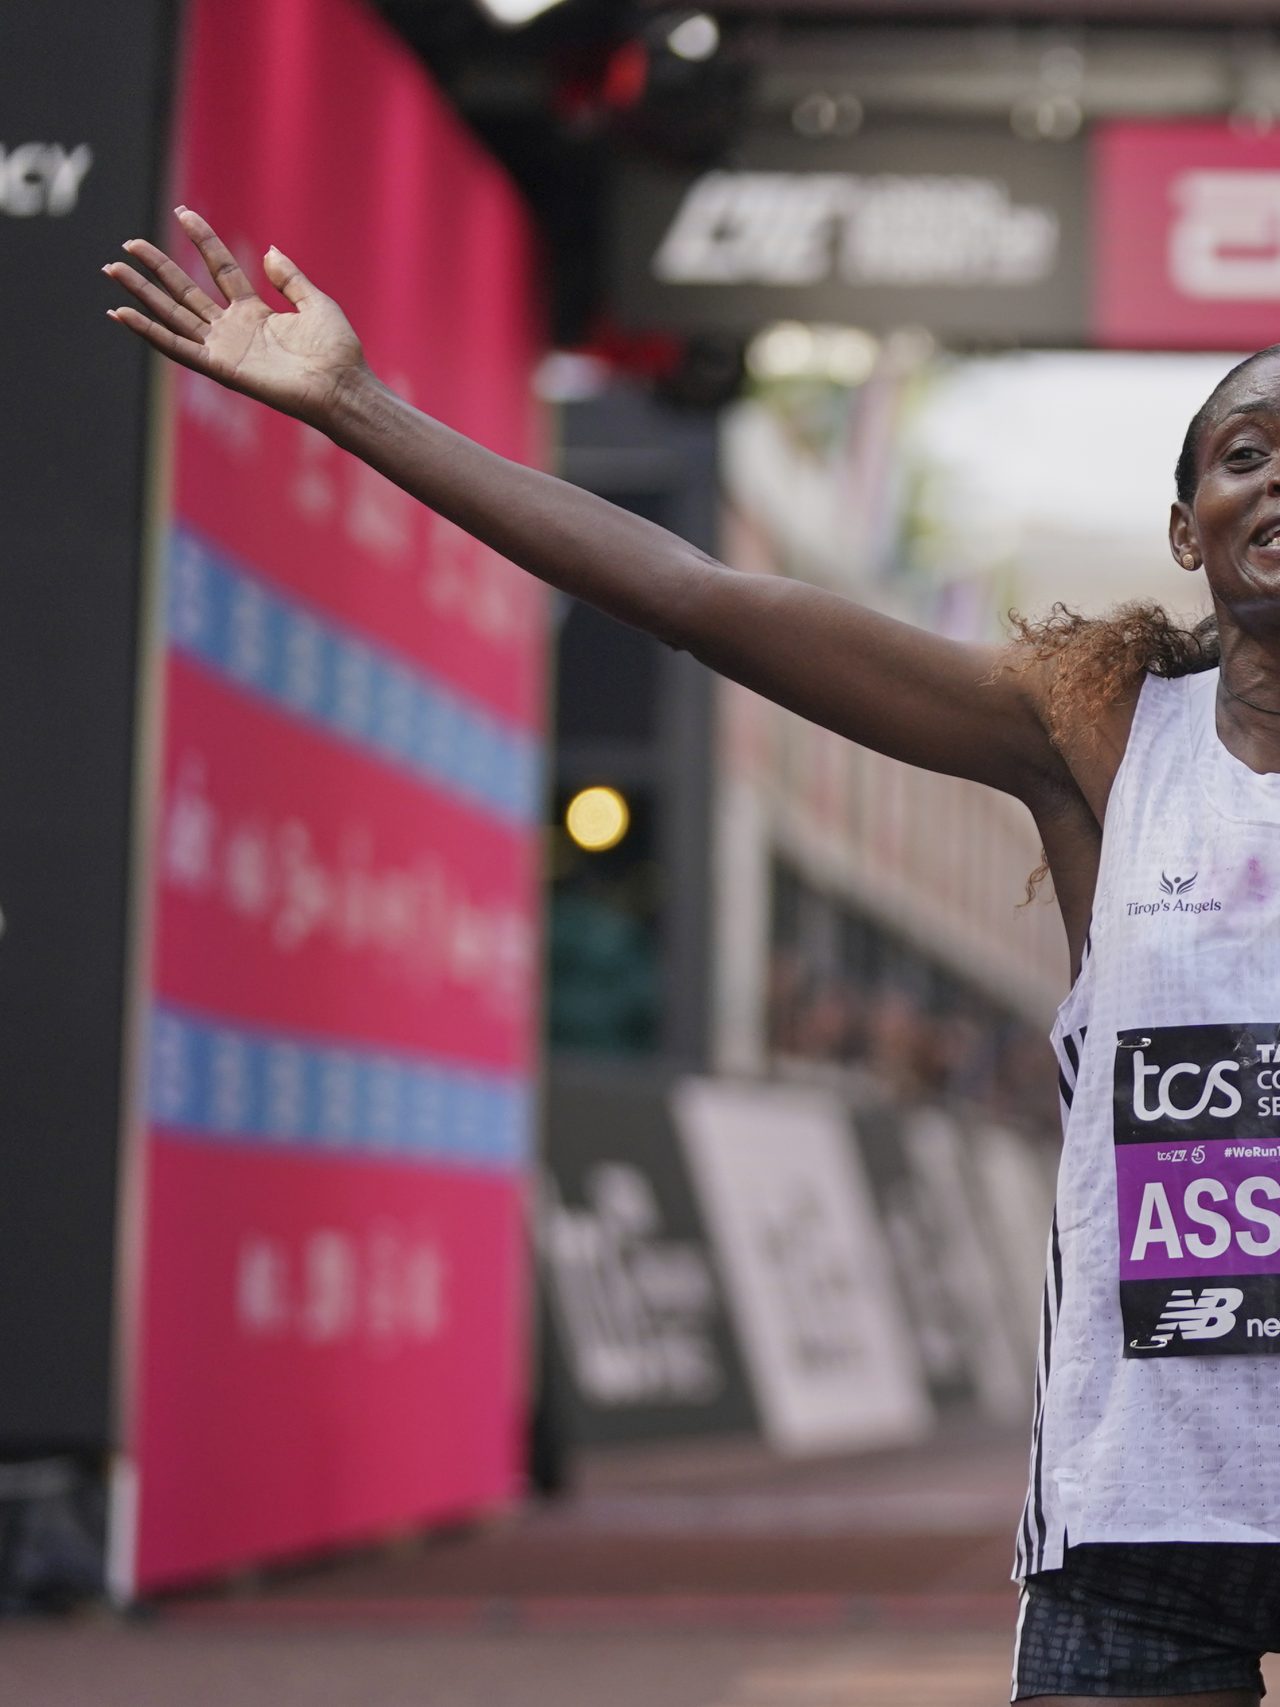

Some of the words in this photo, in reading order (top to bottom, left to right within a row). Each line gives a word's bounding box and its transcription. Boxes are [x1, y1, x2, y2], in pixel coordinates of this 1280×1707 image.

[0, 142, 93, 217] CY
[1126, 899, 1171, 916] Tirop's
[1172, 898, 1222, 914] Angels
[1133, 1050, 1242, 1121] tcs
